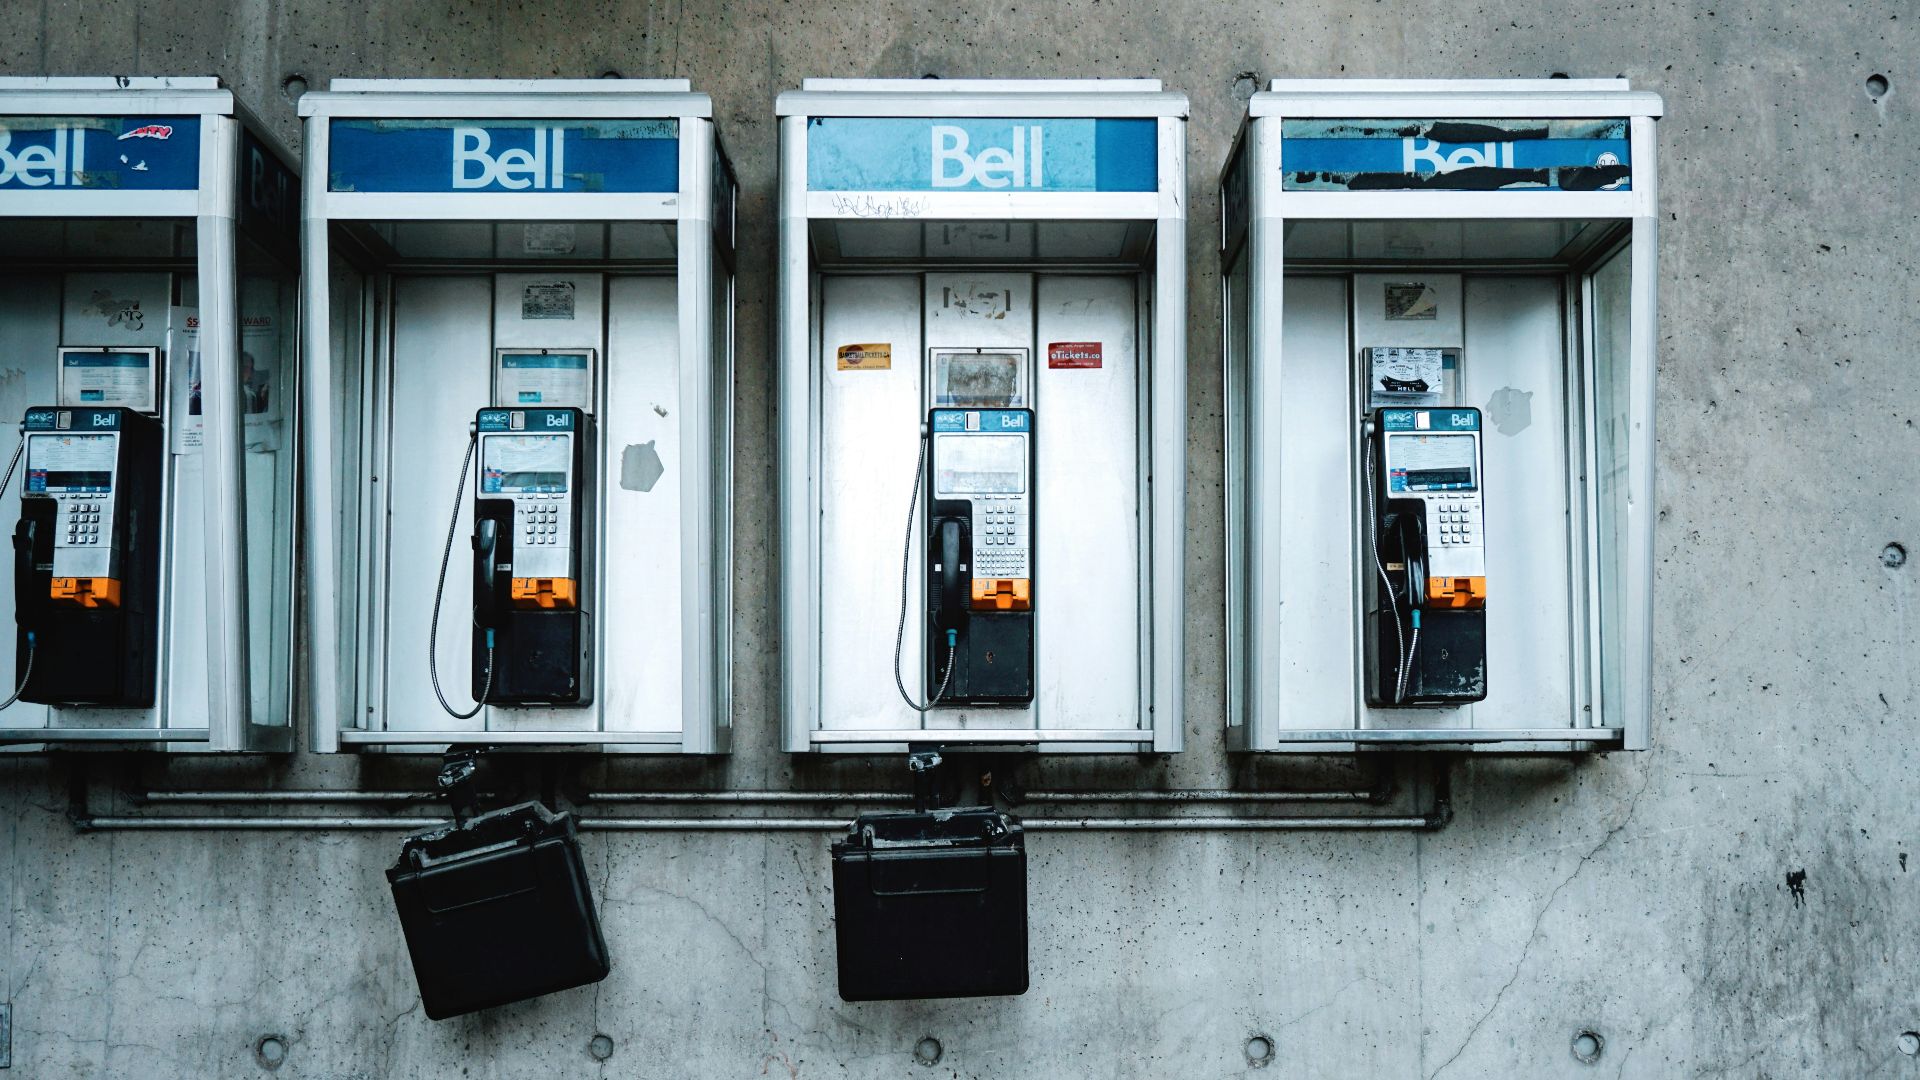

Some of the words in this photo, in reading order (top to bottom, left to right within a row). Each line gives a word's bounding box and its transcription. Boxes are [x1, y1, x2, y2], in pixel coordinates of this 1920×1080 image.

[451, 127, 565, 190] Bell
[931, 125, 1043, 188] Bell
[186, 316, 202, 327] $5
[239, 315, 272, 327] WARD
[93, 413, 115, 426] Bell
[546, 414, 569, 427] Bell
[1001, 414, 1024, 428] Bell
[1451, 413, 1474, 427] Bell
